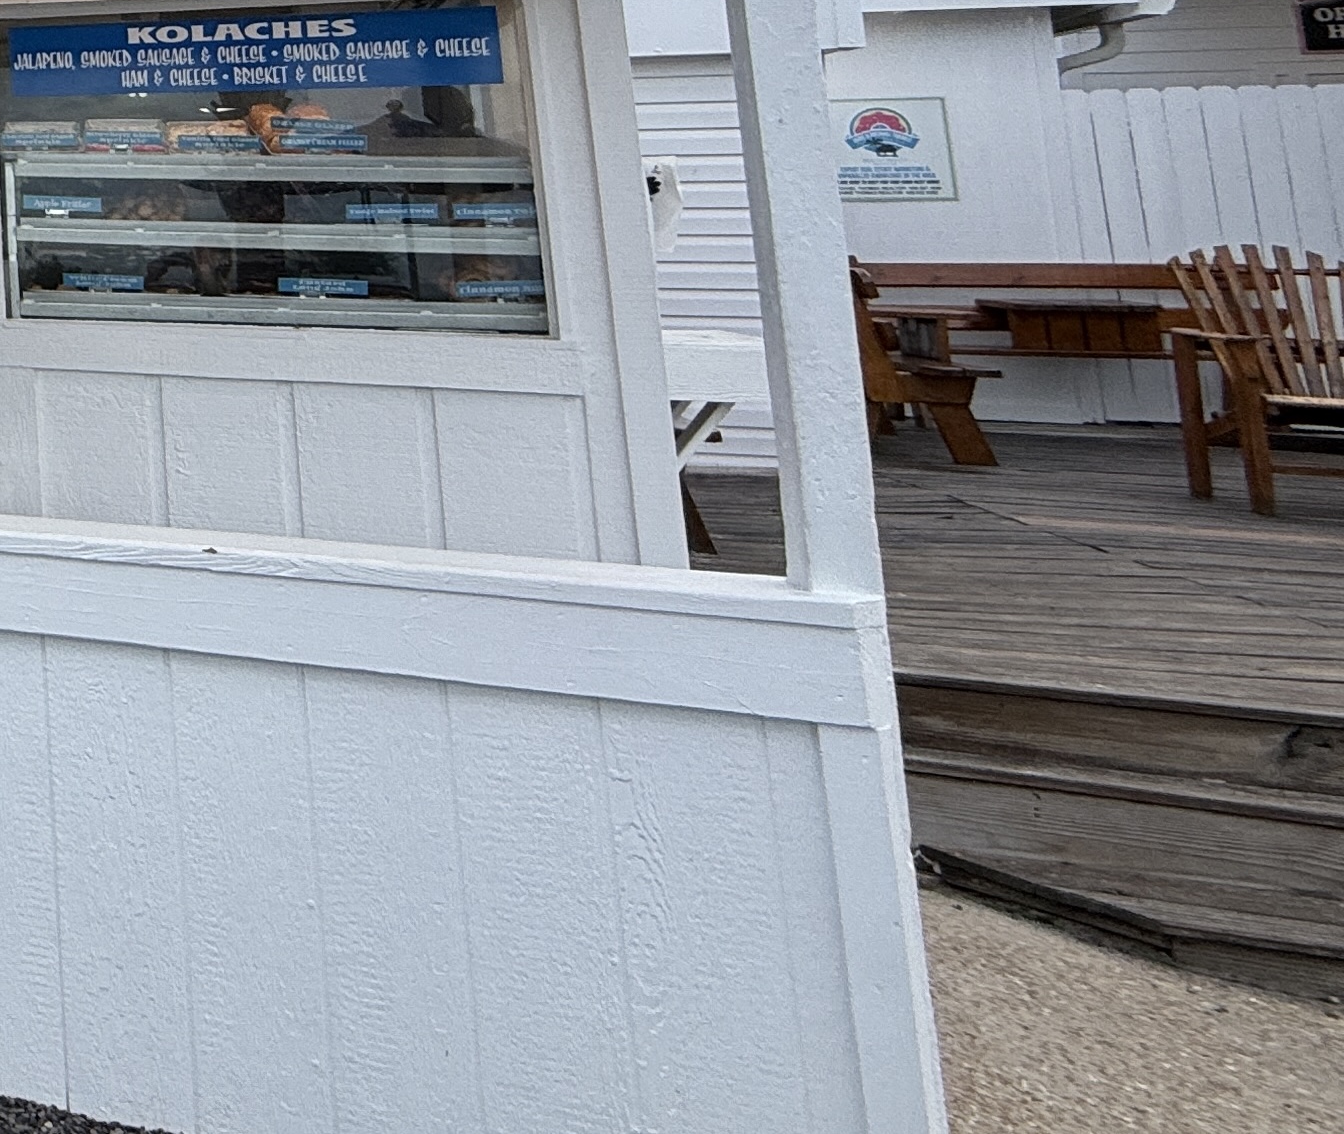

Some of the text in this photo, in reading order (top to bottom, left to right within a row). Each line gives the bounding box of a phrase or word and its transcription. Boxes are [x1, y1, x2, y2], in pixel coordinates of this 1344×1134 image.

[127, 19, 357, 45] KOLACHES
[14, 37, 491, 70] JALAPENO, SMOKED SAUSAGE & CHEESE SMOKED SAUSAGE & CHEESE
[121, 63, 367, 88] HAM & CHEESE BRISKET & CHEESE
